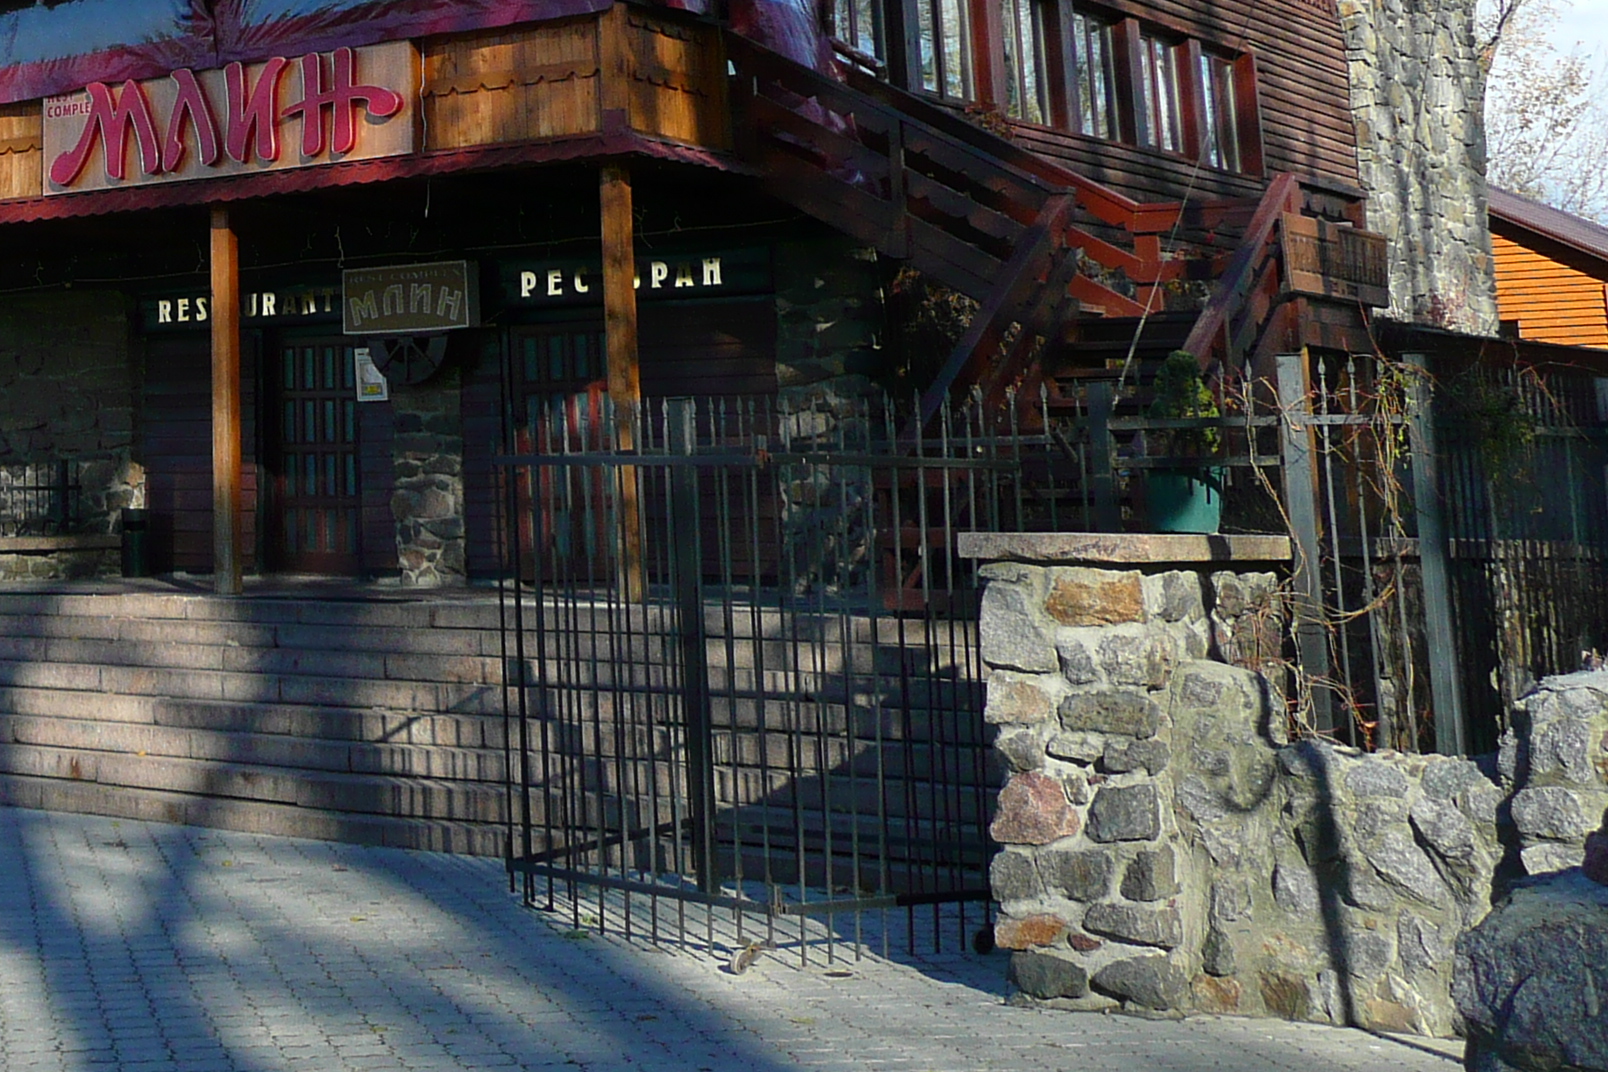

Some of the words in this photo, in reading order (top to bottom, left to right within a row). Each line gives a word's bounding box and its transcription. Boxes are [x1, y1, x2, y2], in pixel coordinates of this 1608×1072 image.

[47, 102, 91, 118] COMPLE
[48, 46, 404, 187] МЛИН
[520, 256, 723, 298] РЕСРАН
[157, 287, 334, 324] RESURANT
